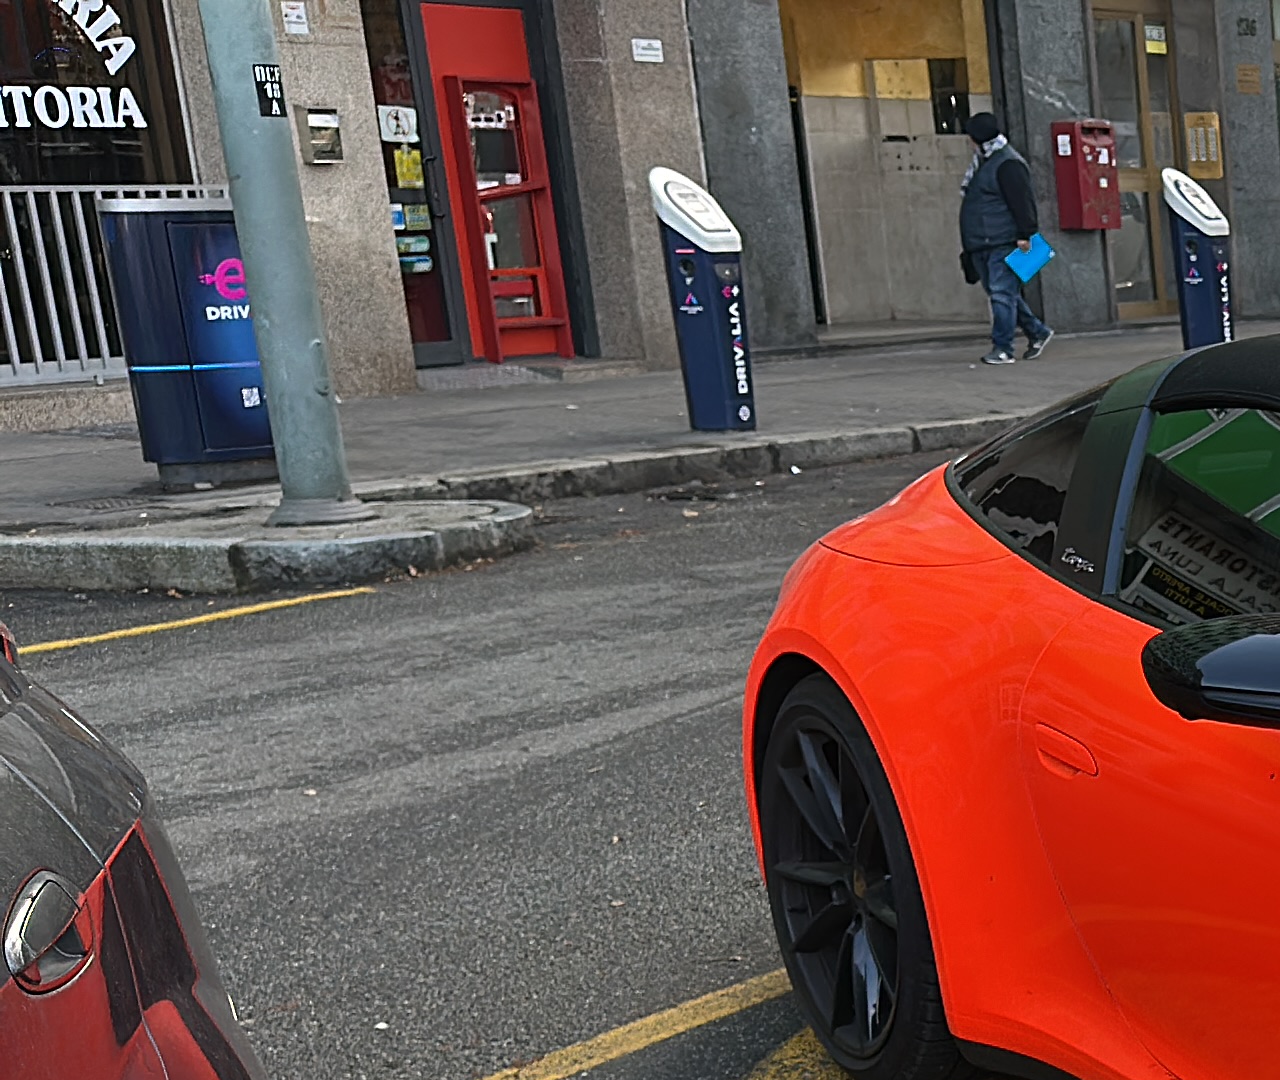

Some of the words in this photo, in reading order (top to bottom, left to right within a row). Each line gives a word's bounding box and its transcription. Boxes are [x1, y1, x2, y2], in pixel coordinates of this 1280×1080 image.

[271, 99, 280, 115] A
[205, 304, 250, 320] DRIV
[729, 302, 749, 394] DRIVALIA
